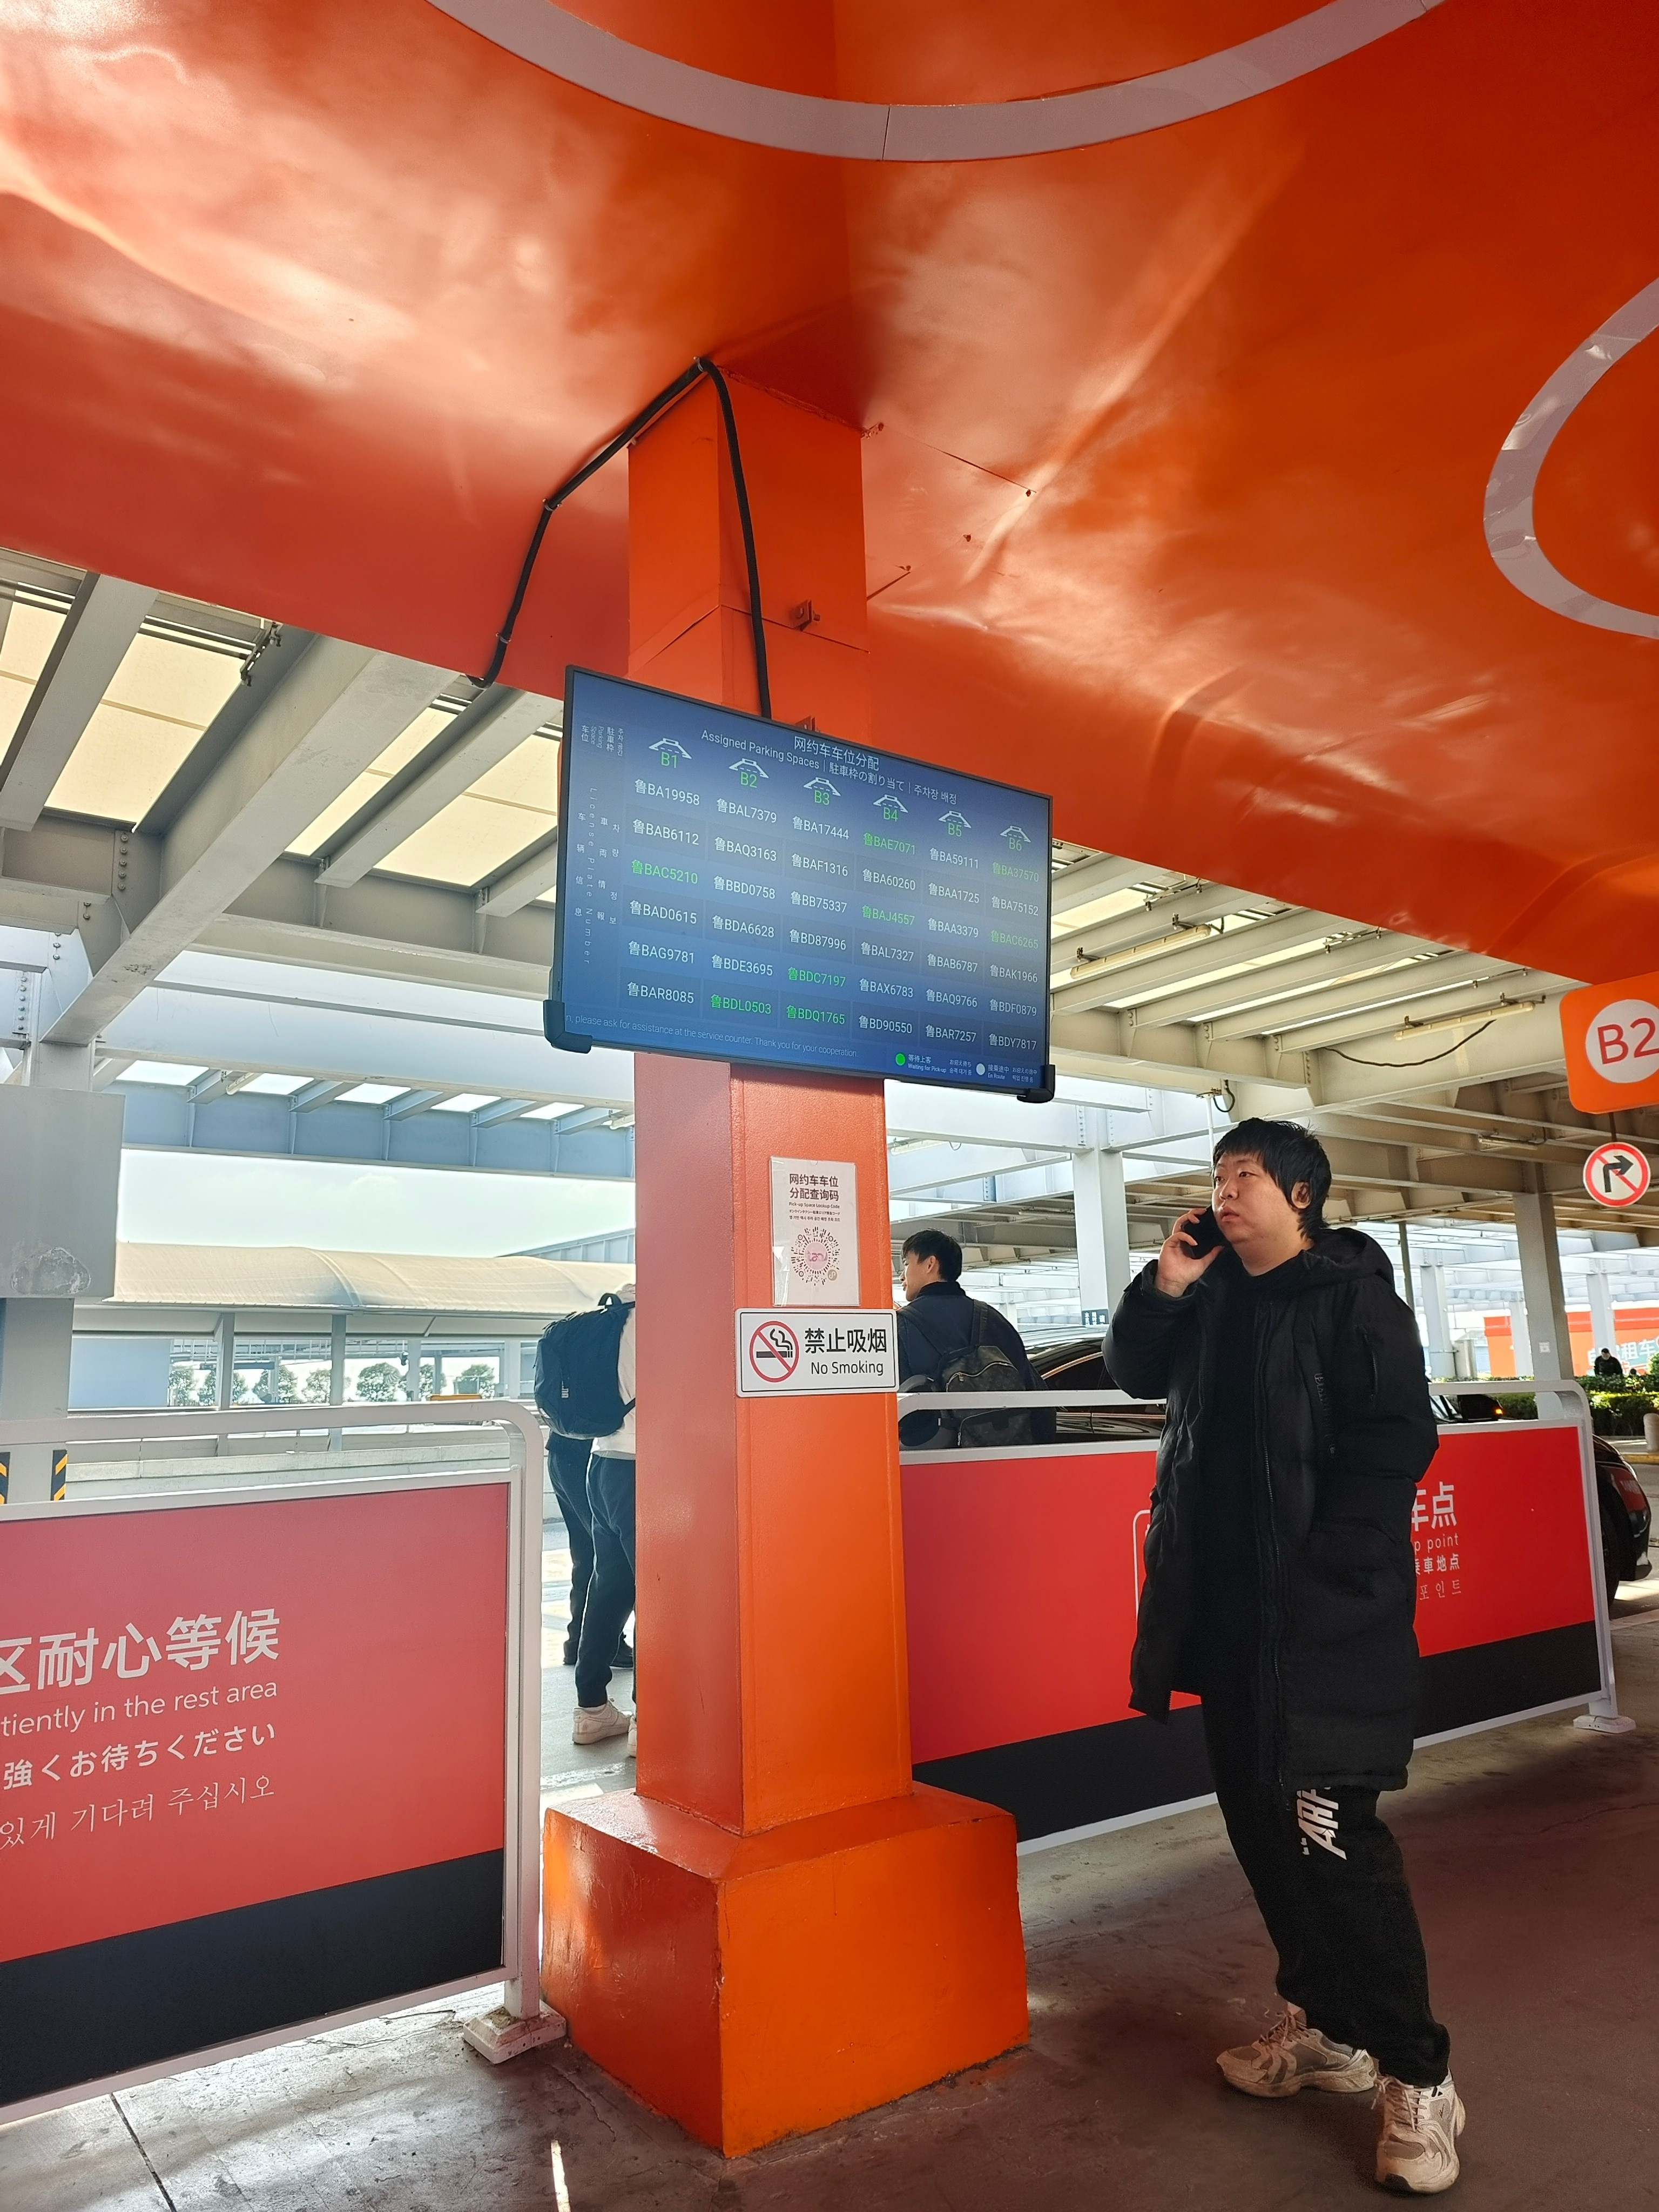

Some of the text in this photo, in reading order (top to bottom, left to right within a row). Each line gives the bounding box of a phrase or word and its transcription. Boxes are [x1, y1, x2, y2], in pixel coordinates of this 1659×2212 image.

[581, 725, 589, 743] 车位
[661, 751, 677, 768] B1
[794, 736, 879, 771] 网约车车位分配
[702, 730, 957, 805] Assigned Parking Spaces 駐車枠の割り当て 주차장 배정
[740, 772, 757, 788] B2
[635, 779, 700, 805] 鲁BA19958
[814, 790, 830, 805] B3
[717, 798, 777, 823] 鲁BAL7379
[884, 807, 898, 822] B4
[632, 819, 699, 845] 鲁BAB6112
[793, 815, 849, 840] 鲁BA17444
[948, 823, 962, 837] B5
[714, 837, 777, 861] 鲁BAQ3163
[1009, 838, 1022, 851] B6
[791, 853, 848, 876] 鲁BAF1316
[929, 847, 979, 869] 鲁BA59111
[631, 859, 698, 884] 鲁BAC5210
[862, 868, 916, 890] 鲁BA60260
[713, 875, 775, 899] 鲁BBD0758
[928, 882, 980, 903] 鲁BAA1725
[630, 900, 697, 924] 鲁BAD0615
[791, 891, 847, 913] 鲁BB75337
[992, 895, 1039, 916] 鲁BA75152
[712, 915, 774, 938] 鲁BDA6628
[928, 918, 979, 938] 鲁BAA3379
[790, 929, 846, 950] 鲁BD87996
[628, 940, 694, 964] 鲁BAG9781
[861, 941, 914, 962] 鲁BAL7327
[711, 954, 773, 976] 鲁BDE3695
[927, 953, 978, 973] 鲁BAB6787
[990, 964, 1038, 982] 鲁BAK1966
[788, 966, 846, 987] 鲁BDC7197
[627, 981, 694, 1003] 鲁BAR8085
[859, 978, 913, 998] 鲁BAX6783
[926, 989, 977, 1007] 鲁BAQ9766
[710, 994, 771, 1015] 鲁BDL0503
[786, 1004, 845, 1024] 鲁BDQ1765
[989, 999, 1037, 1016] 鲁BDF0879
[859, 1015, 913, 1034] 鲁BD90550
[926, 1024, 976, 1042] 鲁BAR7257
[575, 1015, 602, 1027] please
[603, 1019, 617, 1027] ask
[619, 1019, 630, 1029] for
[632, 1022, 673, 1035] assistance
[675, 1027, 683, 1036] at
[684, 1028, 696, 1038] the
[698, 1031, 724, 1041] service
[725, 1033, 753, 1044] counter.
[754, 1036, 777, 1047] Thank
[778, 1041, 790, 1050] you
[792, 1041, 801, 1050] for
[802, 1044, 817, 1053] your
[818, 1046, 858, 1058] cooperation.
[989, 1033, 1037, 1050] 鲁BDY7817
[1597, 1017, 1659, 1064] B2
[908, 1063, 924, 1071] Waiting
[789, 1173, 839, 1187] 网约车车位
[789, 1187, 839, 1202] 分配查询码
[805, 1327, 887, 1354] 禁止吸烟
[811, 1360, 884, 1376] No Smoking
[1427, 1533, 1459, 1553] point
[0, 1608, 280, 1695] 区耐心等候
[1, 1682, 277, 1737] tiently in the rest area
[3, 1723, 275, 1790] 強くお待ちください
[71, 1793, 154, 1832] 기다려
[167, 1775, 274, 1816] 주십시오
